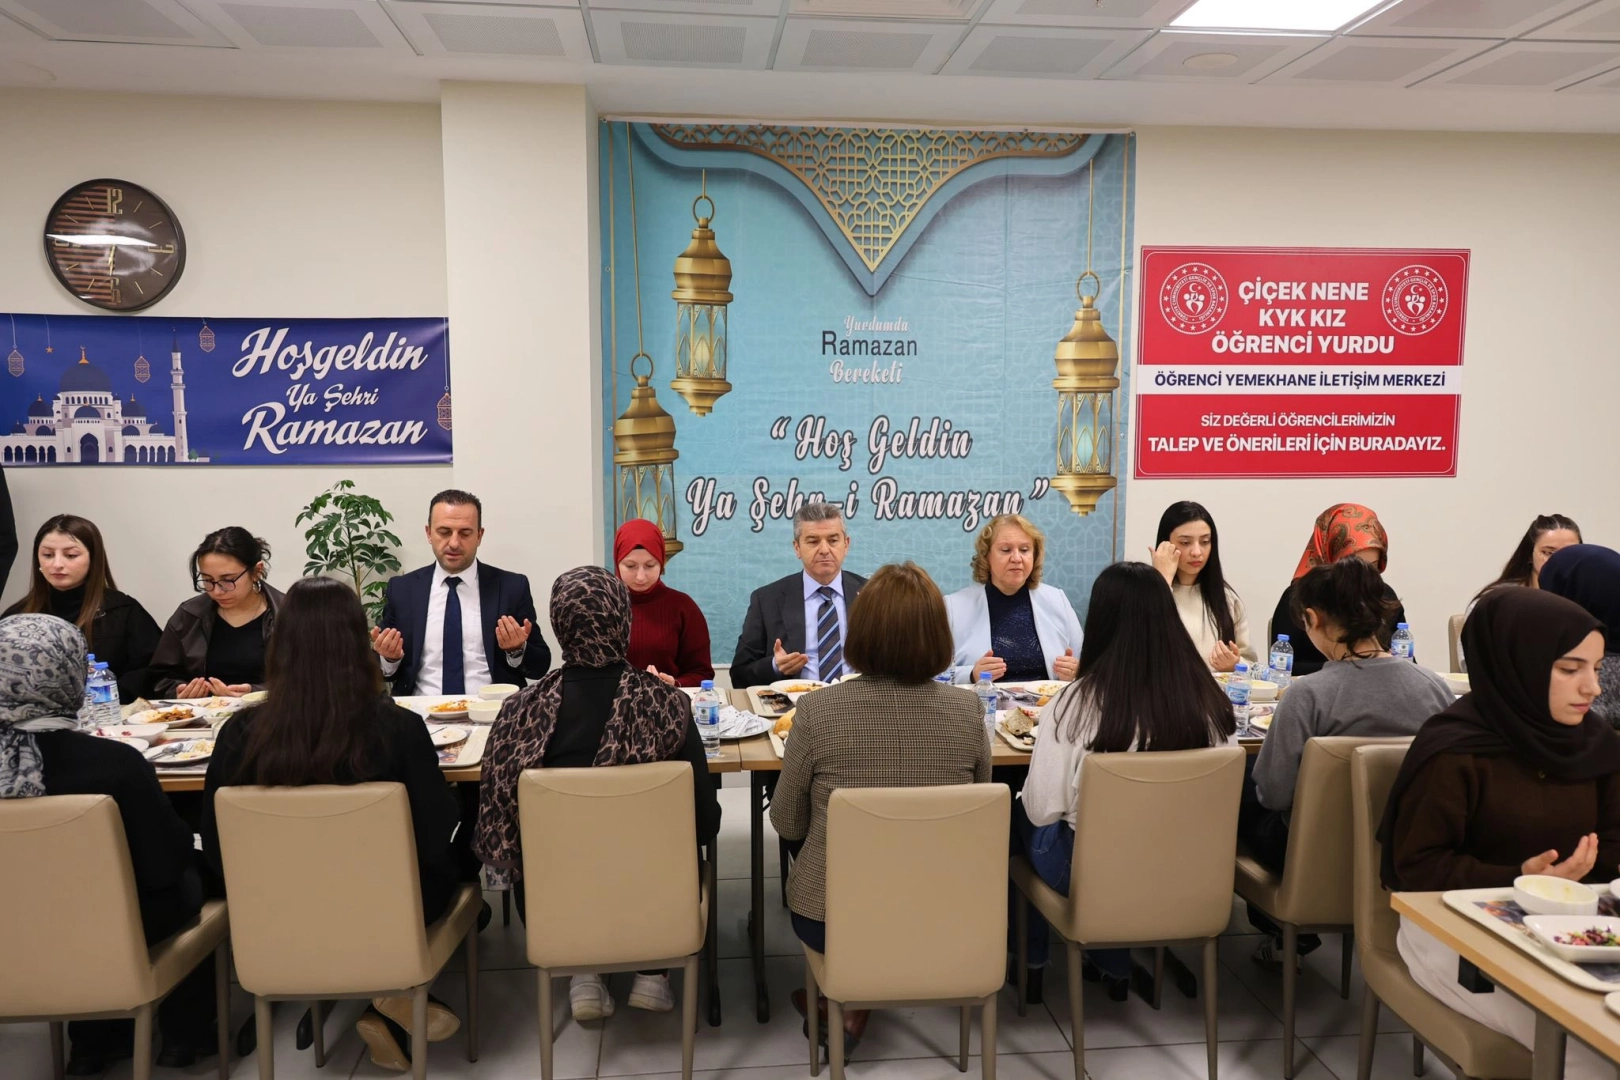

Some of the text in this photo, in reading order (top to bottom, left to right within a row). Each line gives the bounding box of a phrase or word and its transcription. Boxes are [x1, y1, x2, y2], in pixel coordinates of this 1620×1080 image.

[107, 188, 123, 215] 12
[1239, 276, 1369, 305] ÇİÇEK NENE
[843, 315, 909, 336] Yurdumda
[1259, 309, 1346, 327] KYK KIZ
[232, 326, 429, 380] Hoşgeldin
[821, 330, 918, 356] Ramazan
[1212, 330, 1394, 353] ÖĞRENCİ YURDU
[829, 359, 904, 384] Bereketi
[1155, 371, 1445, 389] ÖĞRENCİ YEMEKHANE İLETİŞİM MERKEZİ
[286, 383, 380, 413] Ya Şehri
[242, 400, 429, 455] Ramazan
[1201, 412, 1395, 426] SİZ DEĞERLİ ÖĞRENCİLERİMİZİN
[868, 415, 973, 474] Geldin
[1148, 433, 1445, 455] TALEP VE ÖNERİLERİ İÇİN BURADAYIZ.
[686, 476, 737, 535] Ya
